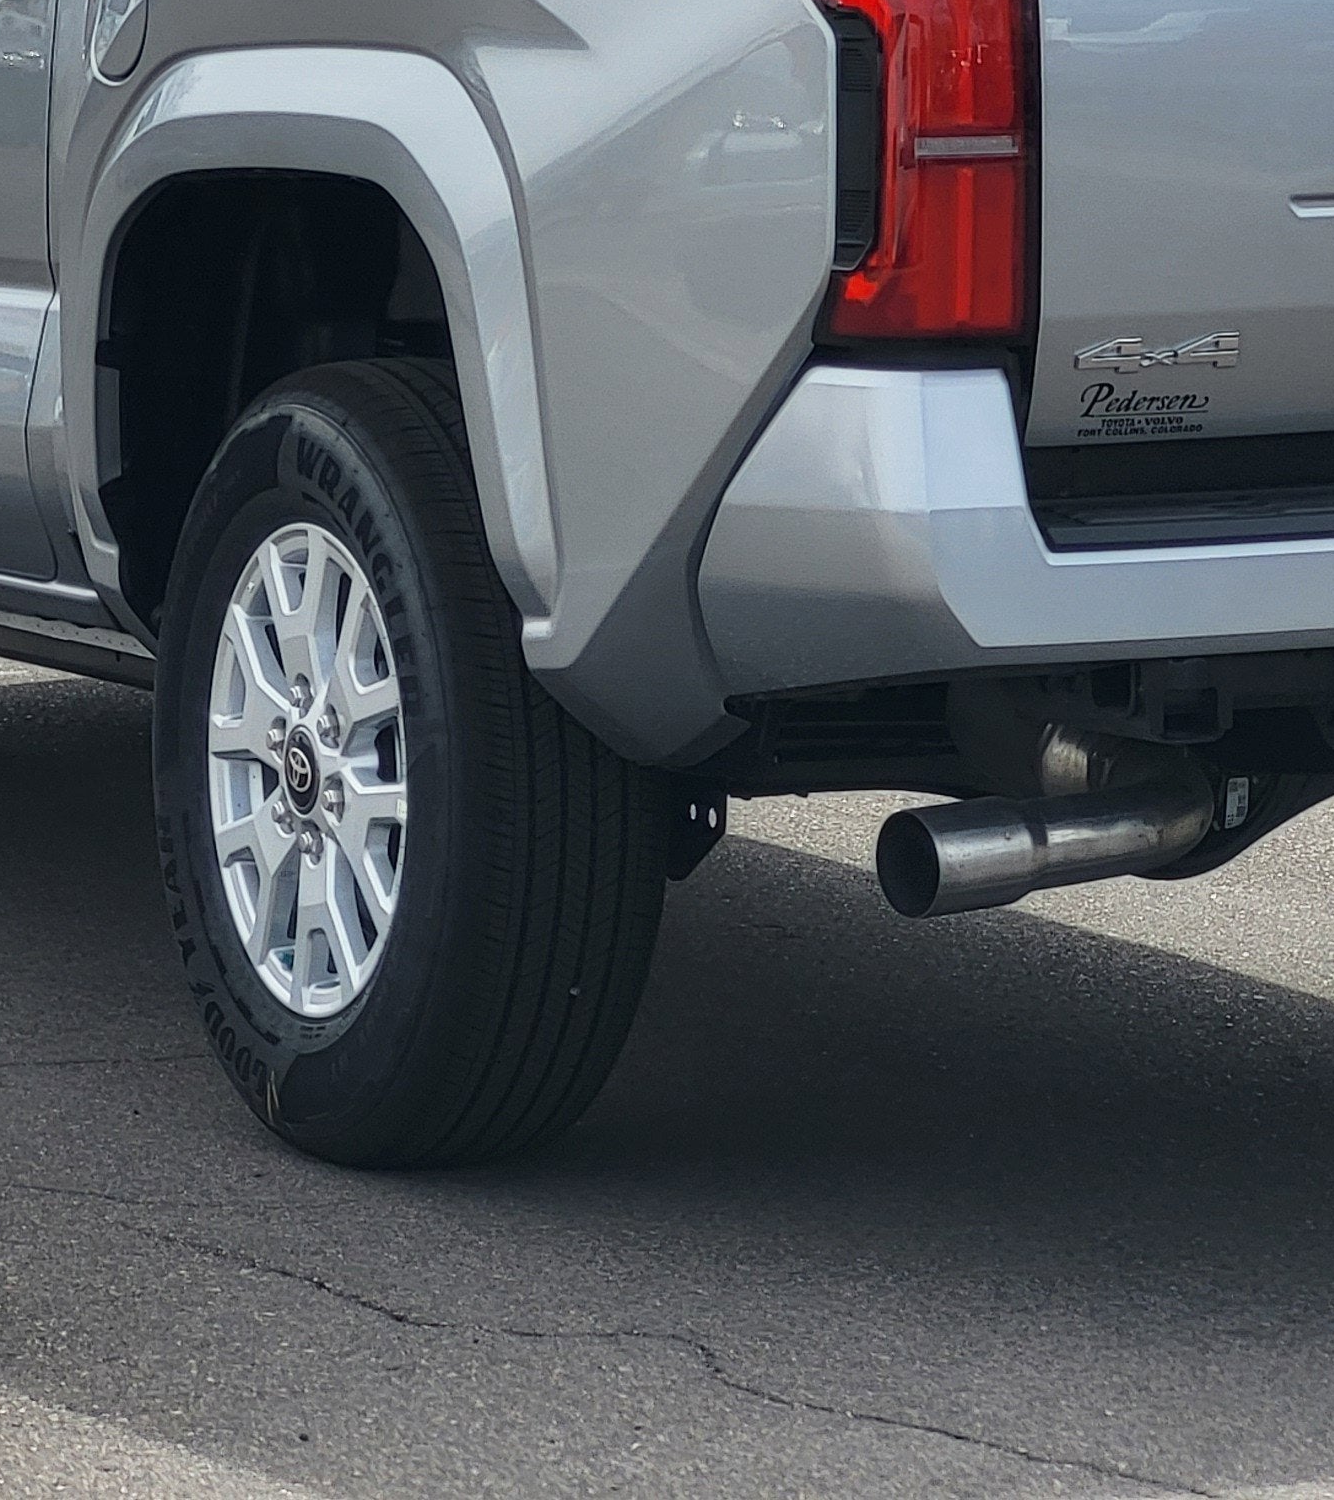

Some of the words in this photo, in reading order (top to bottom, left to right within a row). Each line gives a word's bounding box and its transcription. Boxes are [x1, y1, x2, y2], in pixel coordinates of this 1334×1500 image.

[1080, 382, 1209, 418] Pedersen
[1077, 428, 1102, 437] FORT
[1151, 424, 1203, 435] COLORADO
[1101, 418, 1136, 428] TOYOTA
[1145, 416, 1183, 426] VOLVO
[296, 434, 421, 718] WRANGLER
